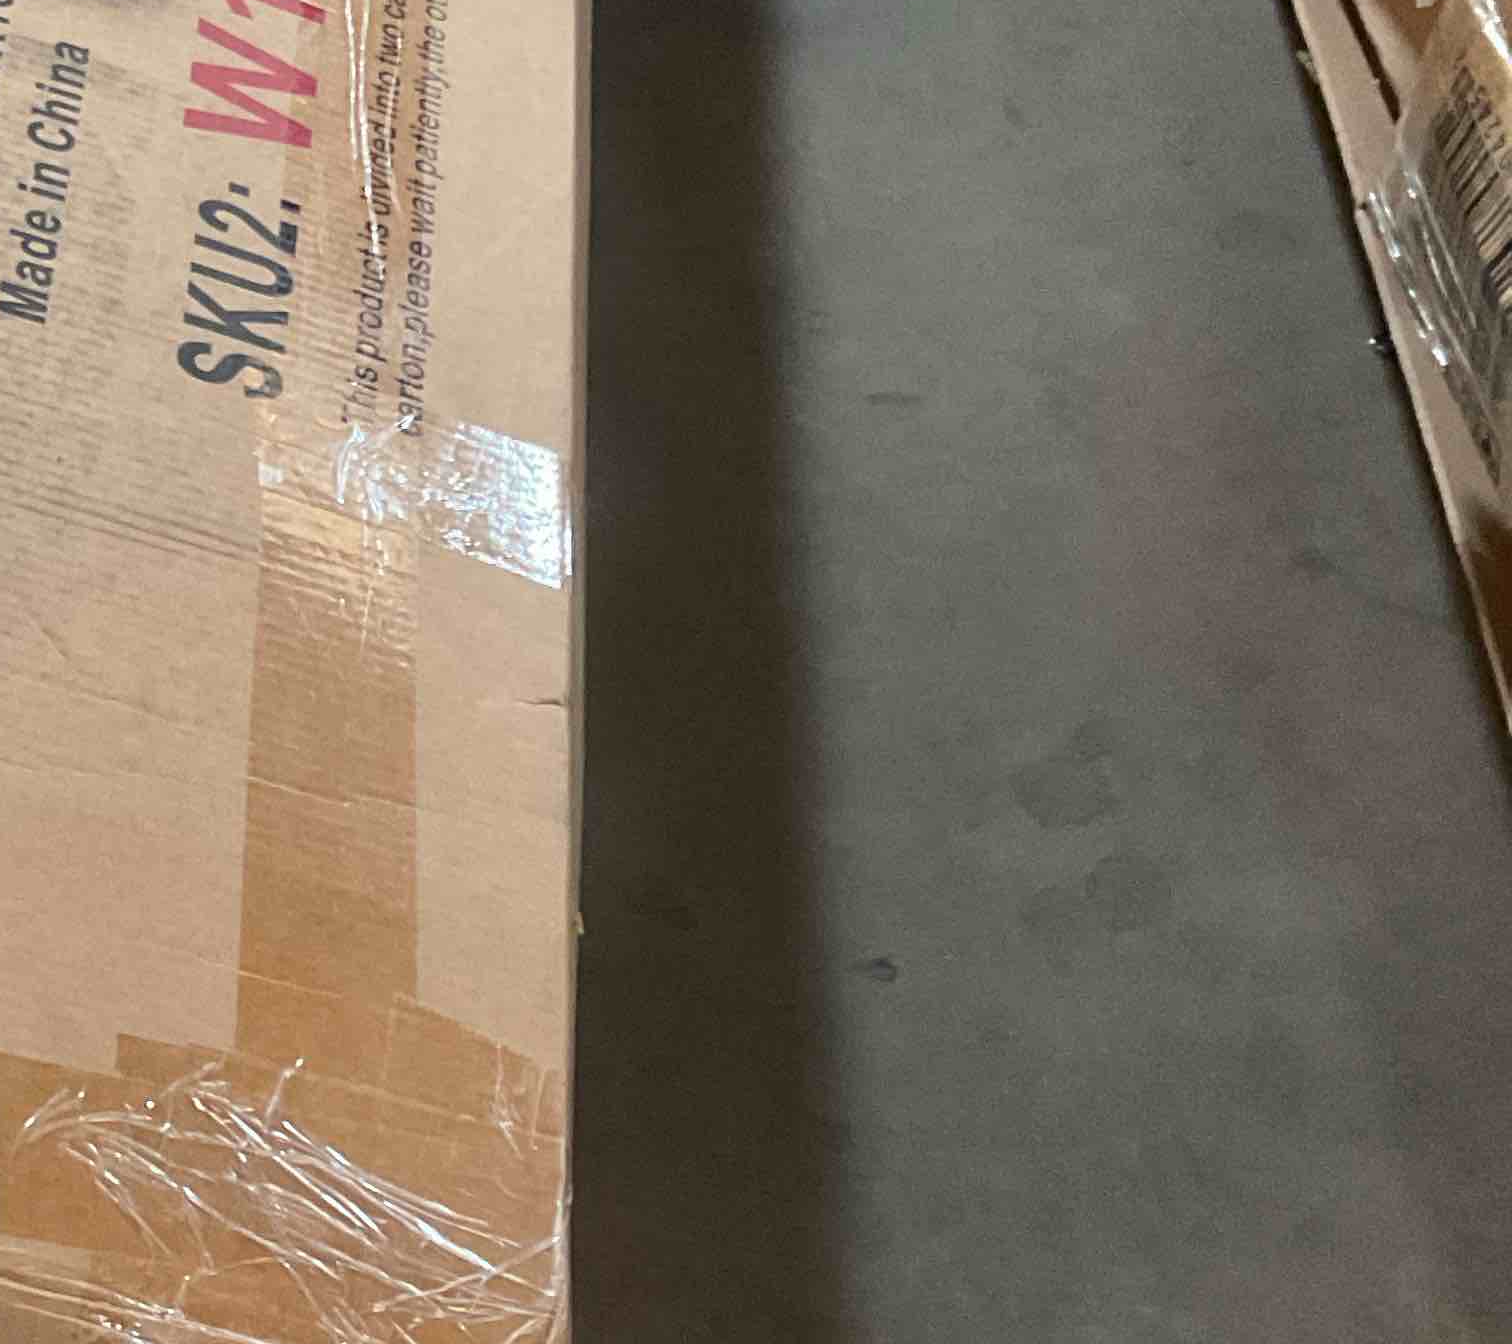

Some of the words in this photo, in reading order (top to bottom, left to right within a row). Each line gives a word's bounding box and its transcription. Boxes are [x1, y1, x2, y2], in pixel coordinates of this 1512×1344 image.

[375, 22, 402, 67] two
[27, 41, 89, 152] China
[368, 69, 401, 117] into
[18, 161, 70, 202] in
[407, 177, 437, 240] wait
[357, 222, 388, 248] is
[177, 182, 301, 399] SKU2:
[353, 248, 388, 364] product
[341, 364, 379, 426] This
